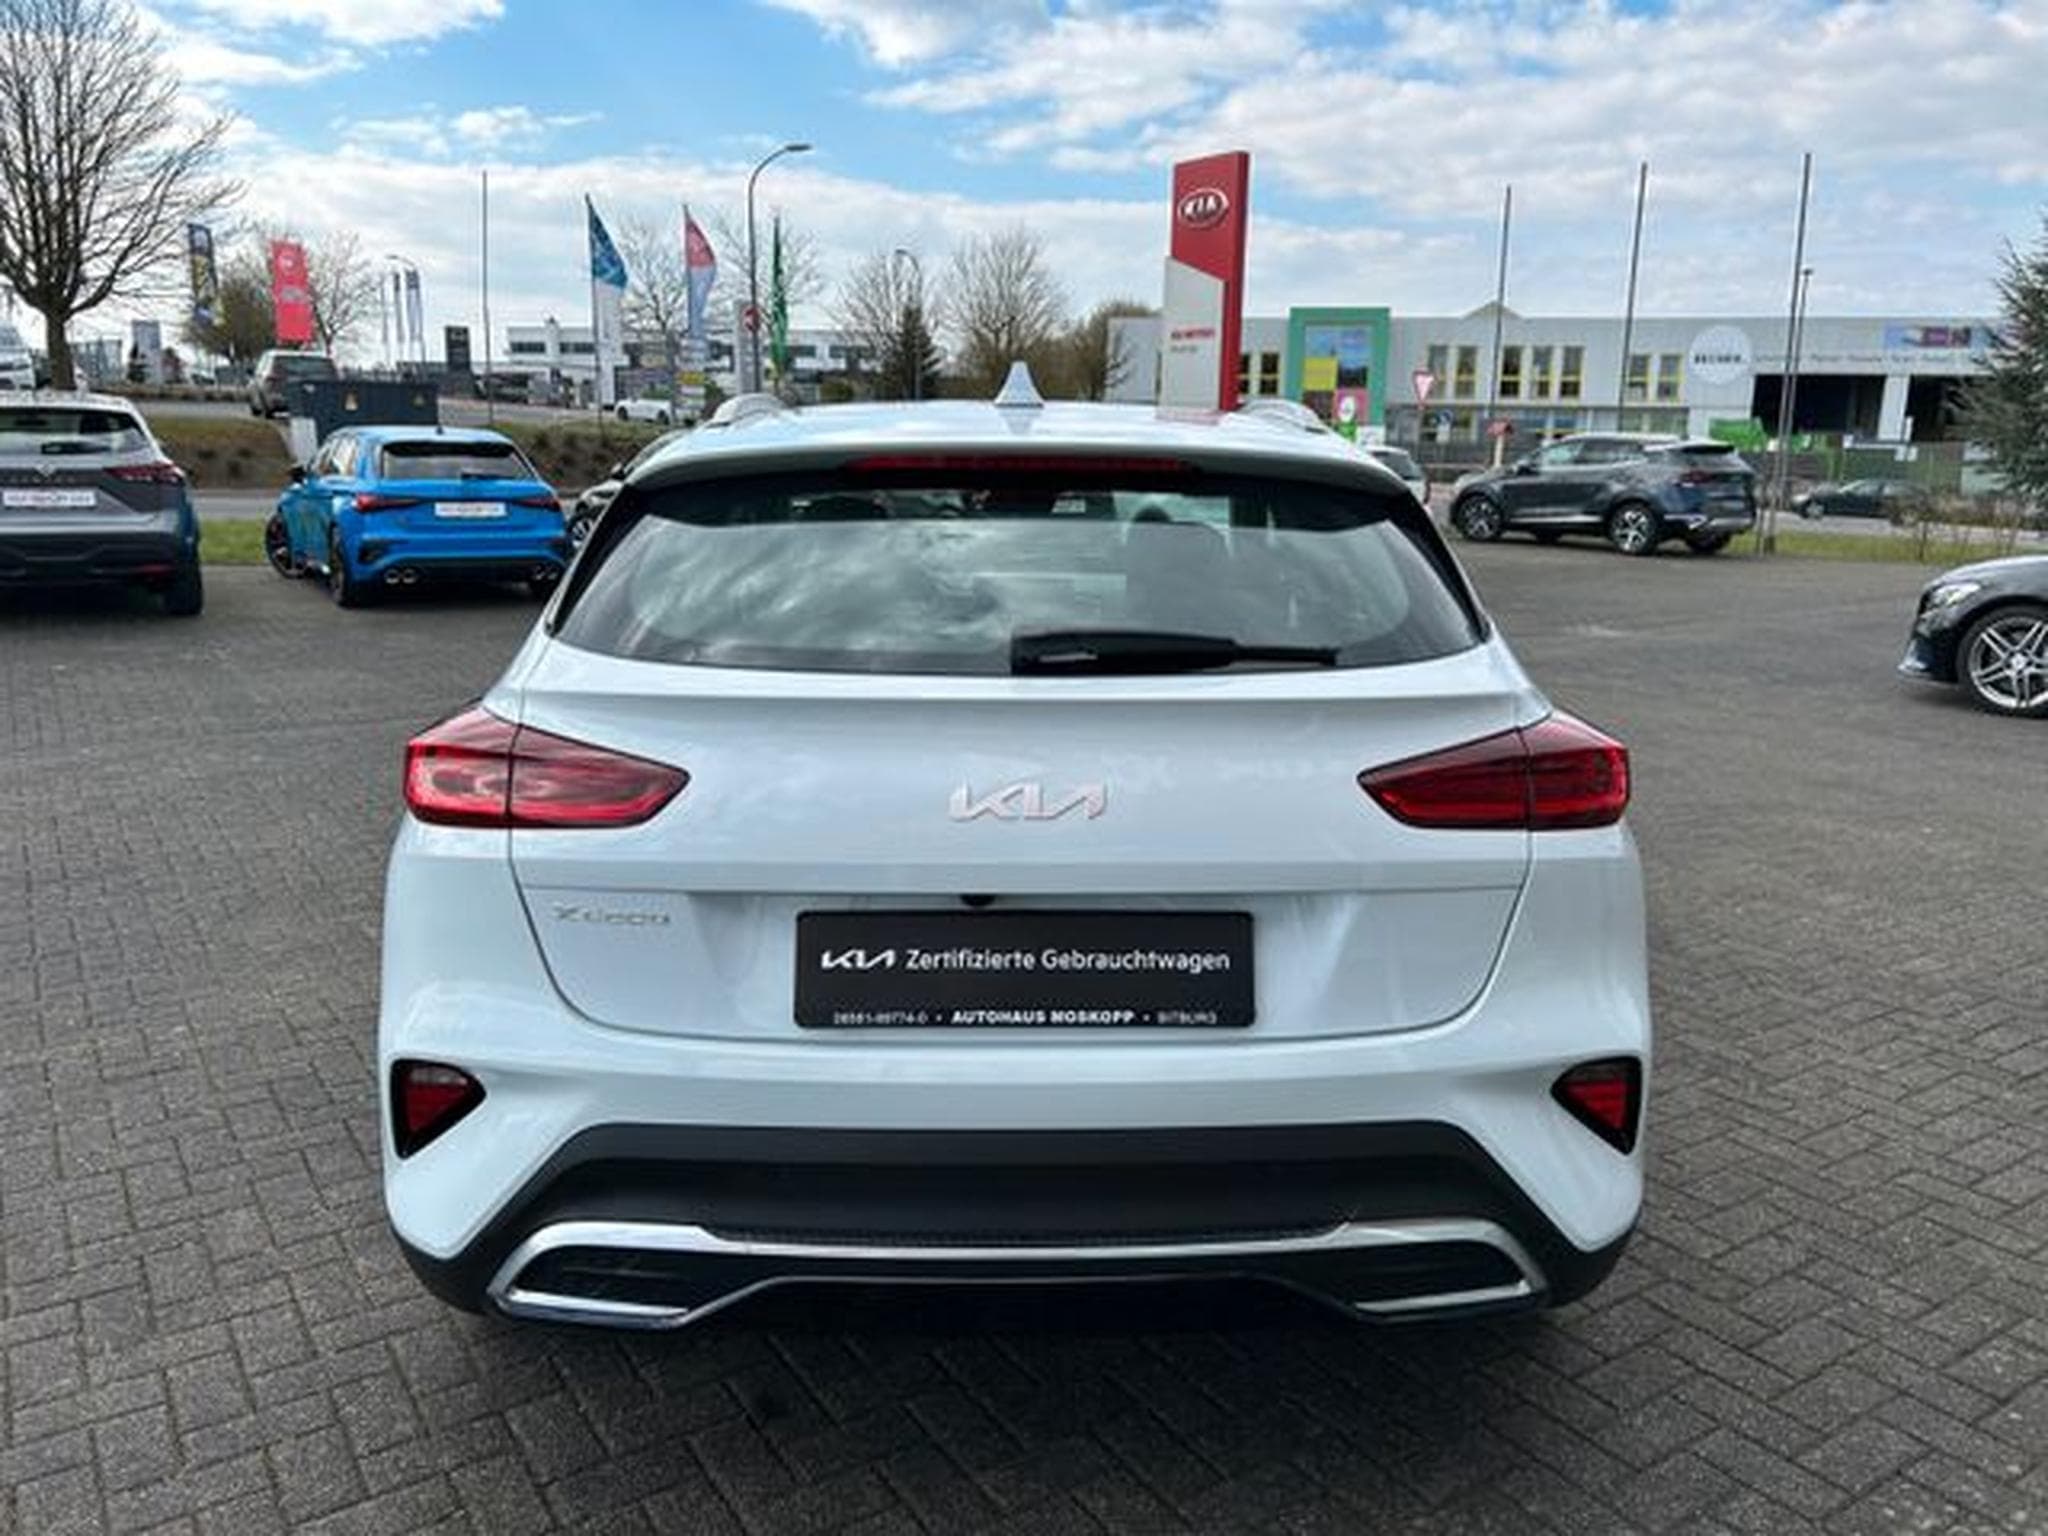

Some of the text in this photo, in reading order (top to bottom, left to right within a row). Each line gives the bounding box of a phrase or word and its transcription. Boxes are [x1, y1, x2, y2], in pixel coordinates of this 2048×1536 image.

[949, 781, 1108, 821] KIA
[820, 948, 1231, 974] KIA Zertifizierte Gebrauchtwagen
[950, 1009, 1046, 1025] AUTOHAUS
